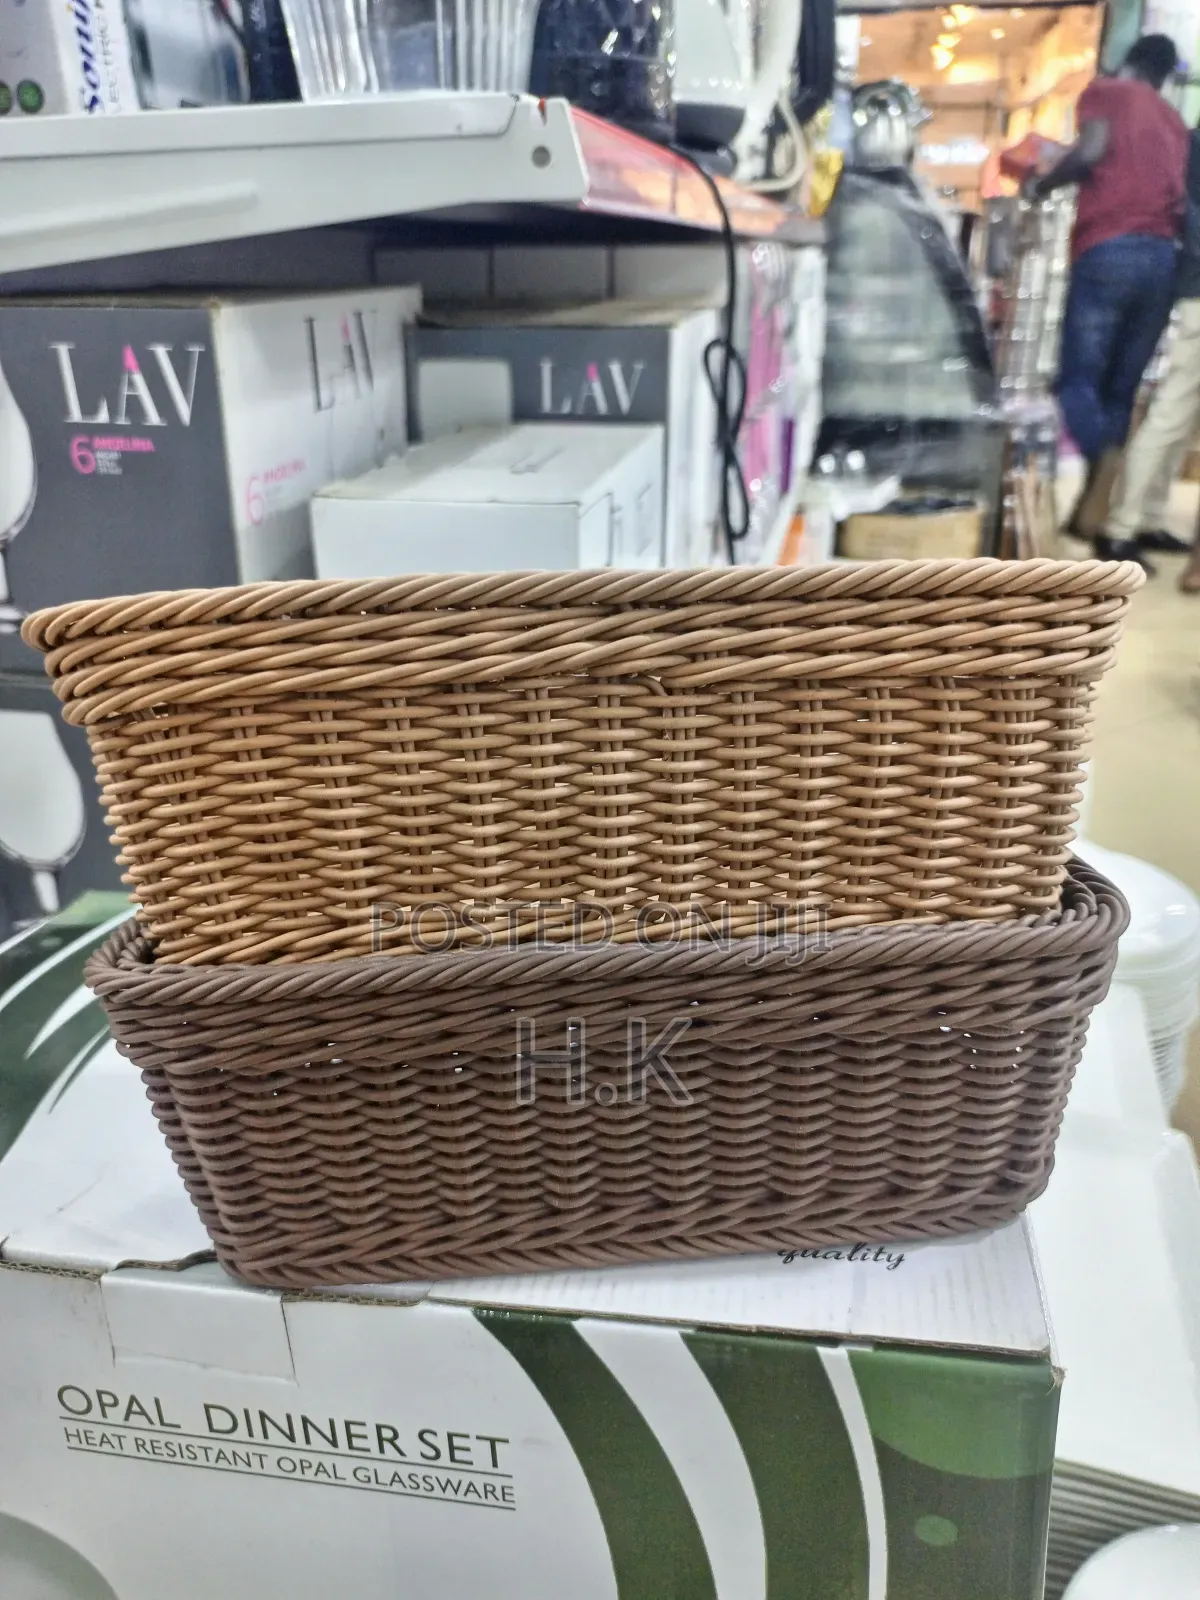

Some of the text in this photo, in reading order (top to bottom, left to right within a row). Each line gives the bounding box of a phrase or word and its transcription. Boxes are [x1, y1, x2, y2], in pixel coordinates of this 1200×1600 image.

[49, 341, 206, 427] LAV
[540, 357, 646, 416] LAV
[69, 434, 97, 475] 6
[776, 1242, 906, 1271] quality
[57, 1384, 510, 1469] OPAL DINNER SET
[64, 1426, 516, 1503] HEAT RESISTANT OPAL GLASSWARE
